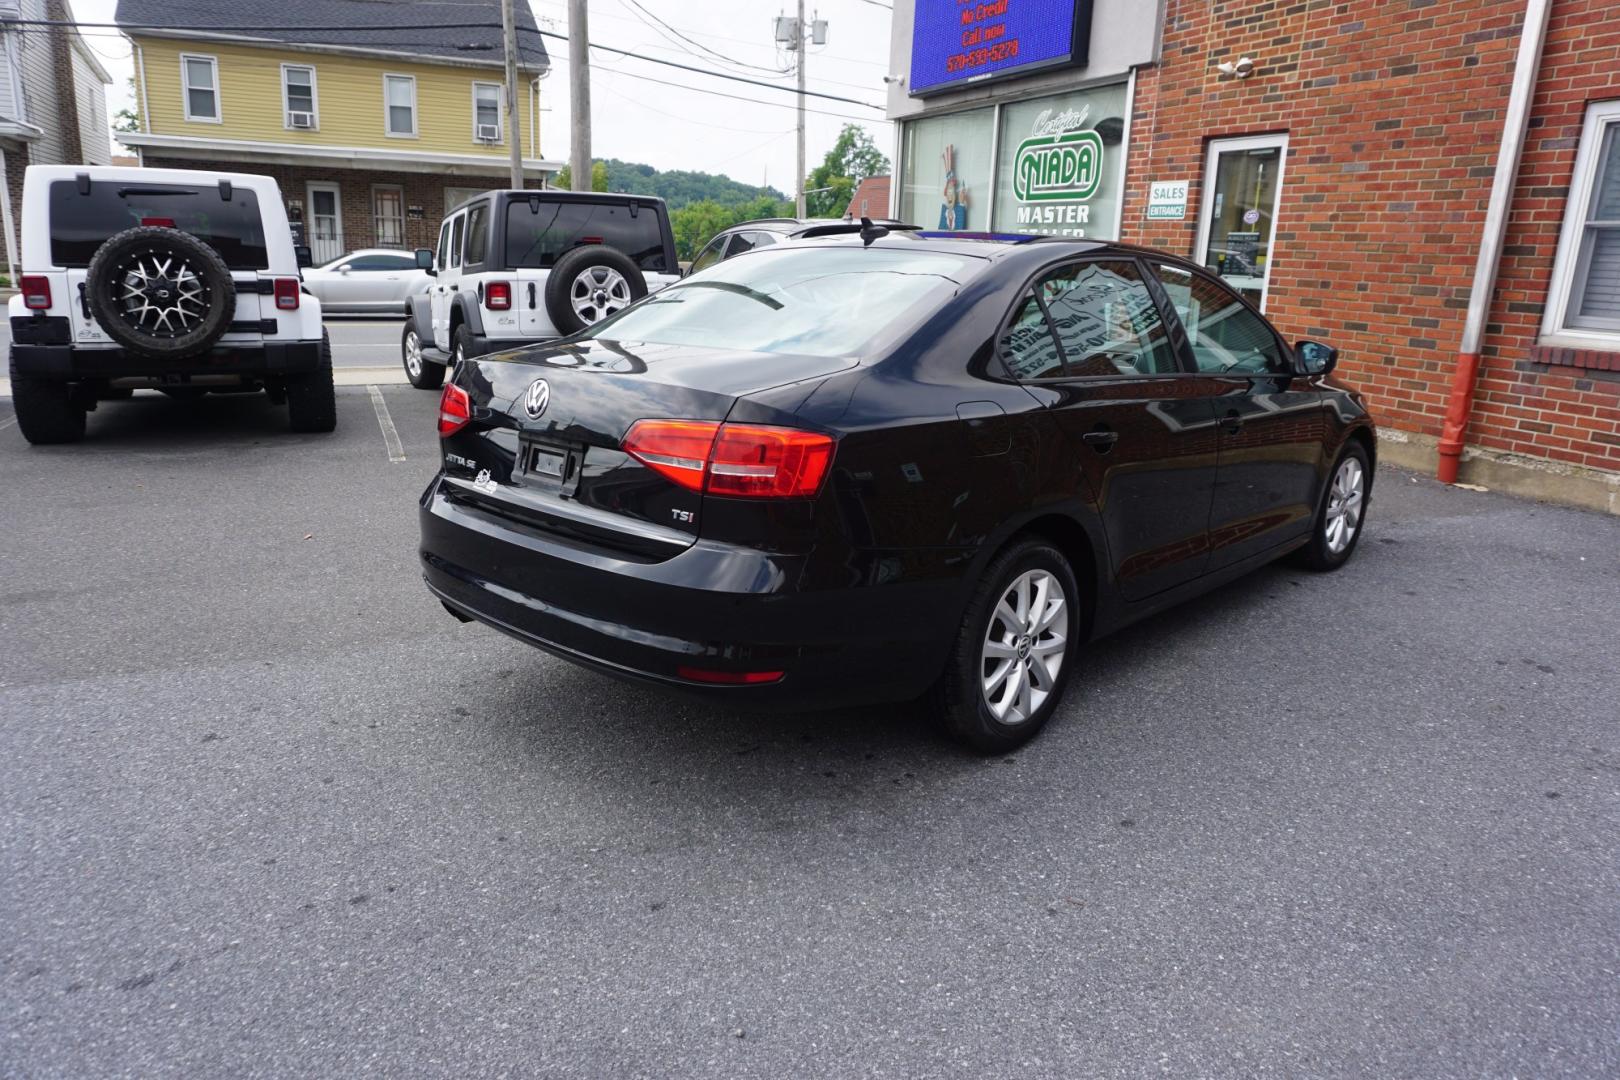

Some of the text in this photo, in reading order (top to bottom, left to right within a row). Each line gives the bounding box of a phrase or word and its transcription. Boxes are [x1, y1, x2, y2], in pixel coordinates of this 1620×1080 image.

[961, 0, 1008, 25] No Credit
[961, 23, 1005, 47] Call now
[1021, 145, 1093, 189] NIADA
[1153, 187, 1185, 200] SALES
[1016, 205, 1089, 223] MASTER
[1151, 205, 1184, 216] ENTRANCE
[446, 453, 476, 469] JETTA SE
[671, 508, 694, 523] TSI
